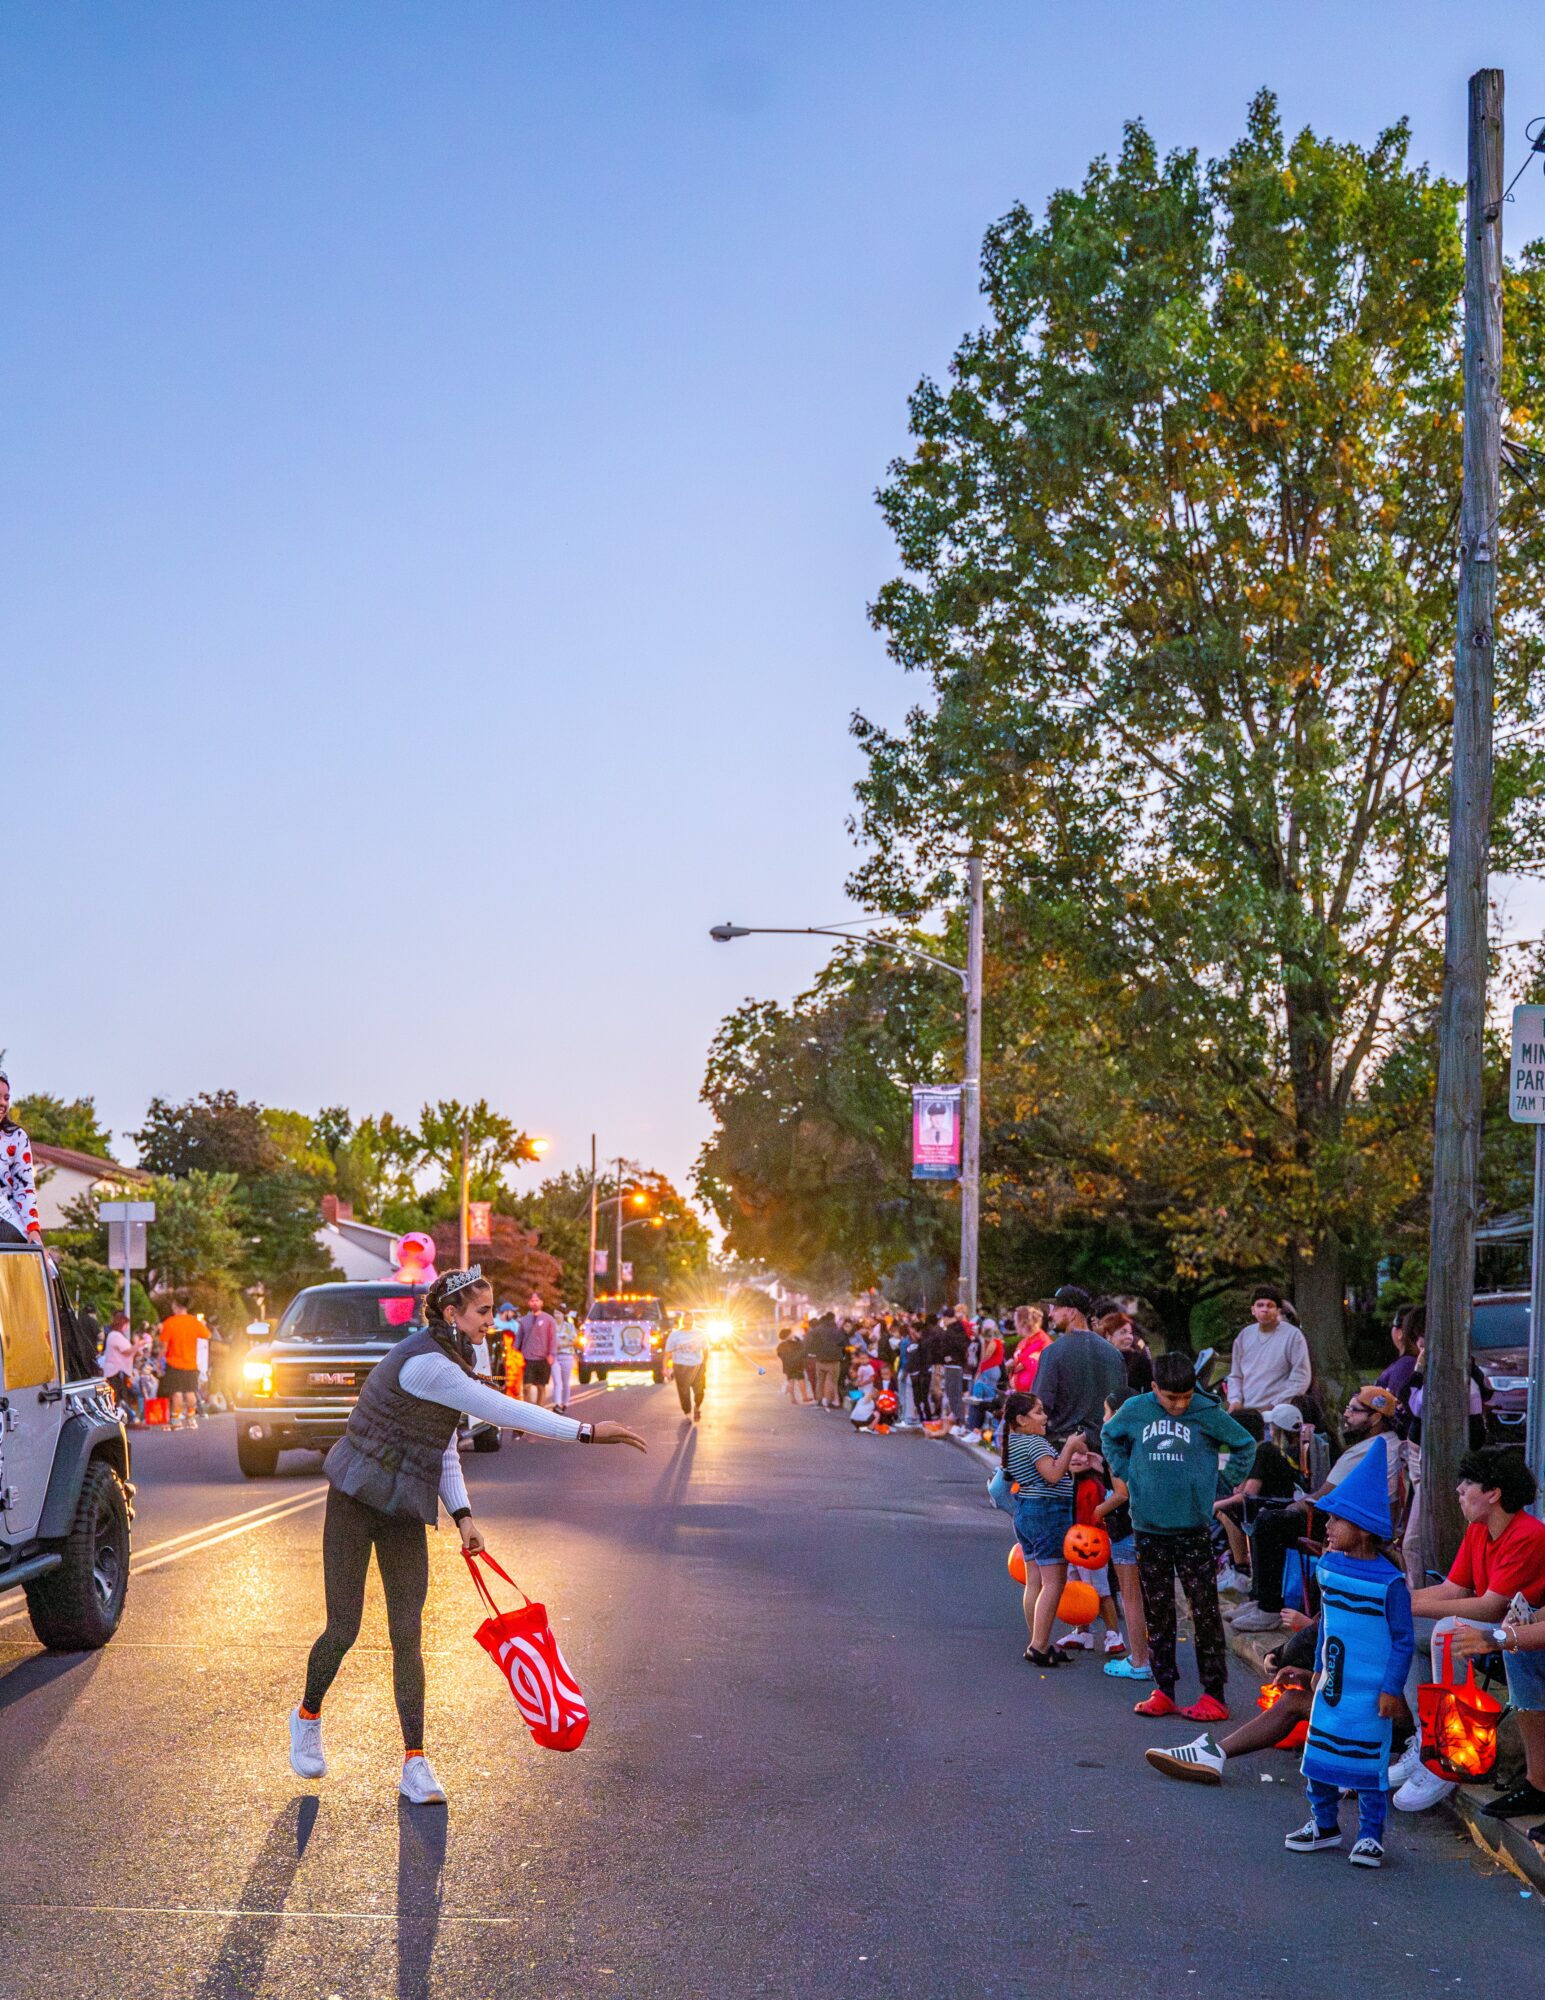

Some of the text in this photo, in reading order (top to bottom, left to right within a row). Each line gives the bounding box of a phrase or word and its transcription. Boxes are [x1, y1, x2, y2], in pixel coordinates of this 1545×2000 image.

[1516, 1095, 1536, 1110] 7AM
[308, 1372, 356, 1385] GMC
[1142, 1419, 1191, 1444] EAGLES
[1148, 1452, 1184, 1462] FOOTBALL
[1325, 1643, 1340, 1698] Crayon
